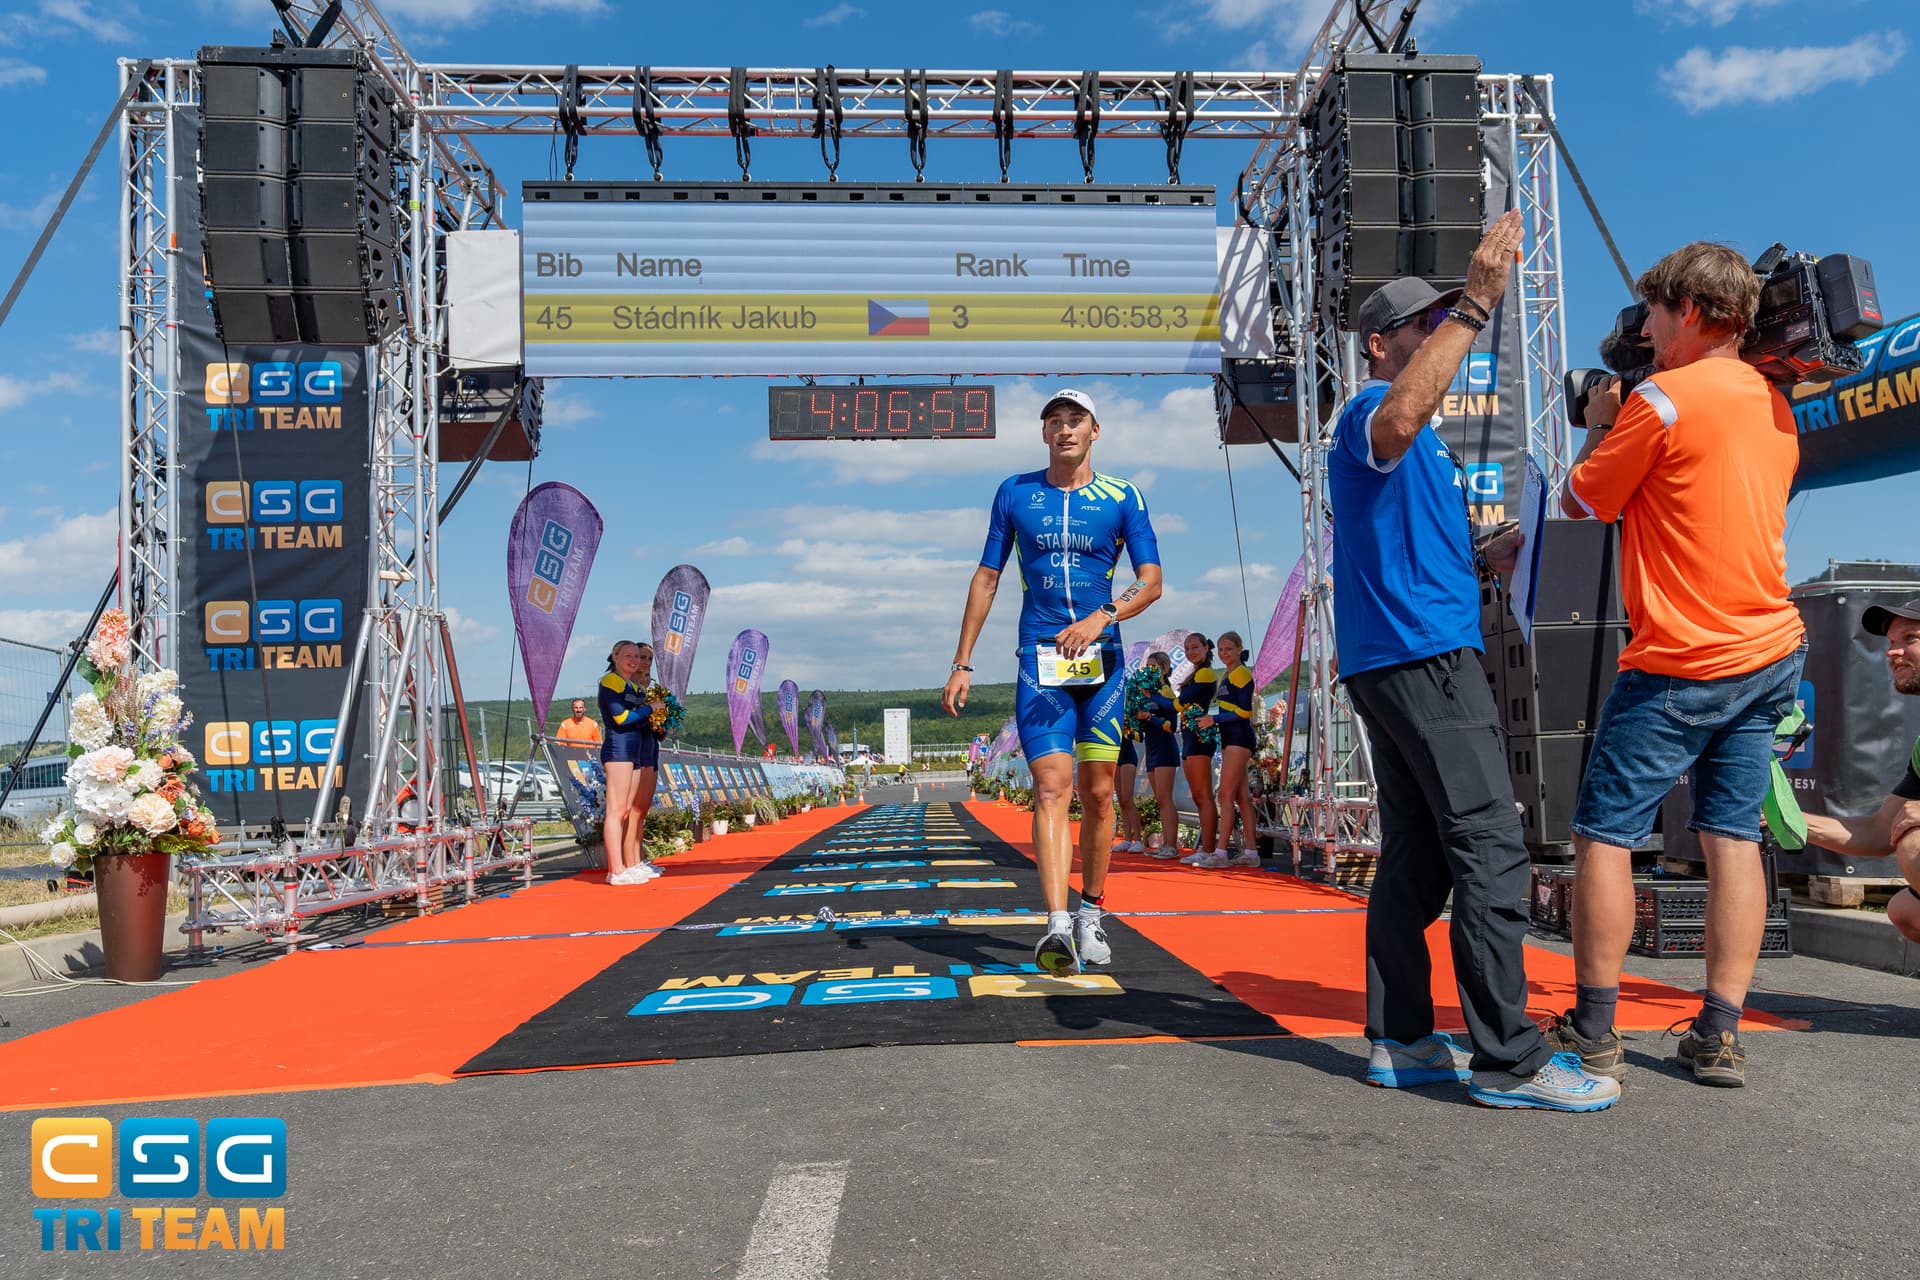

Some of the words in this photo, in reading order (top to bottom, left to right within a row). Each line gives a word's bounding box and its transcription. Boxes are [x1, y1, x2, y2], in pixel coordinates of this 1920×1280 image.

[536, 252, 584, 278] Bib
[616, 252, 703, 278] Name
[956, 253, 1030, 278] Rank
[1063, 253, 1132, 278] Time
[536, 306, 573, 330] 45
[612, 304, 722, 330] Stádník
[731, 304, 818, 330] Jakub
[952, 305, 970, 330] 3
[1060, 305, 1189, 333] 4:06:58,3
[208, 368, 338, 399] CSG
[206, 407, 255, 431] TRI
[259, 406, 342, 430] TEAM
[811, 391, 988, 432] 4:06:59
[1433, 394, 1500, 416] EAM
[1792, 394, 1840, 434] TRI
[209, 486, 338, 517] CSG
[206, 527, 255, 551] TRI
[260, 525, 343, 549] TEAM
[530, 522, 571, 609] CSG
[1050, 551, 1081, 568] CZE
[208, 605, 337, 637] CSG
[206, 648, 255, 671] TRI
[261, 644, 342, 670] TEAM
[1066, 661, 1091, 676] 45
[208, 725, 338, 759] CSG
[206, 768, 255, 793] TRI
[260, 765, 344, 791] TEAM
[656, 965, 930, 990] TEAM
